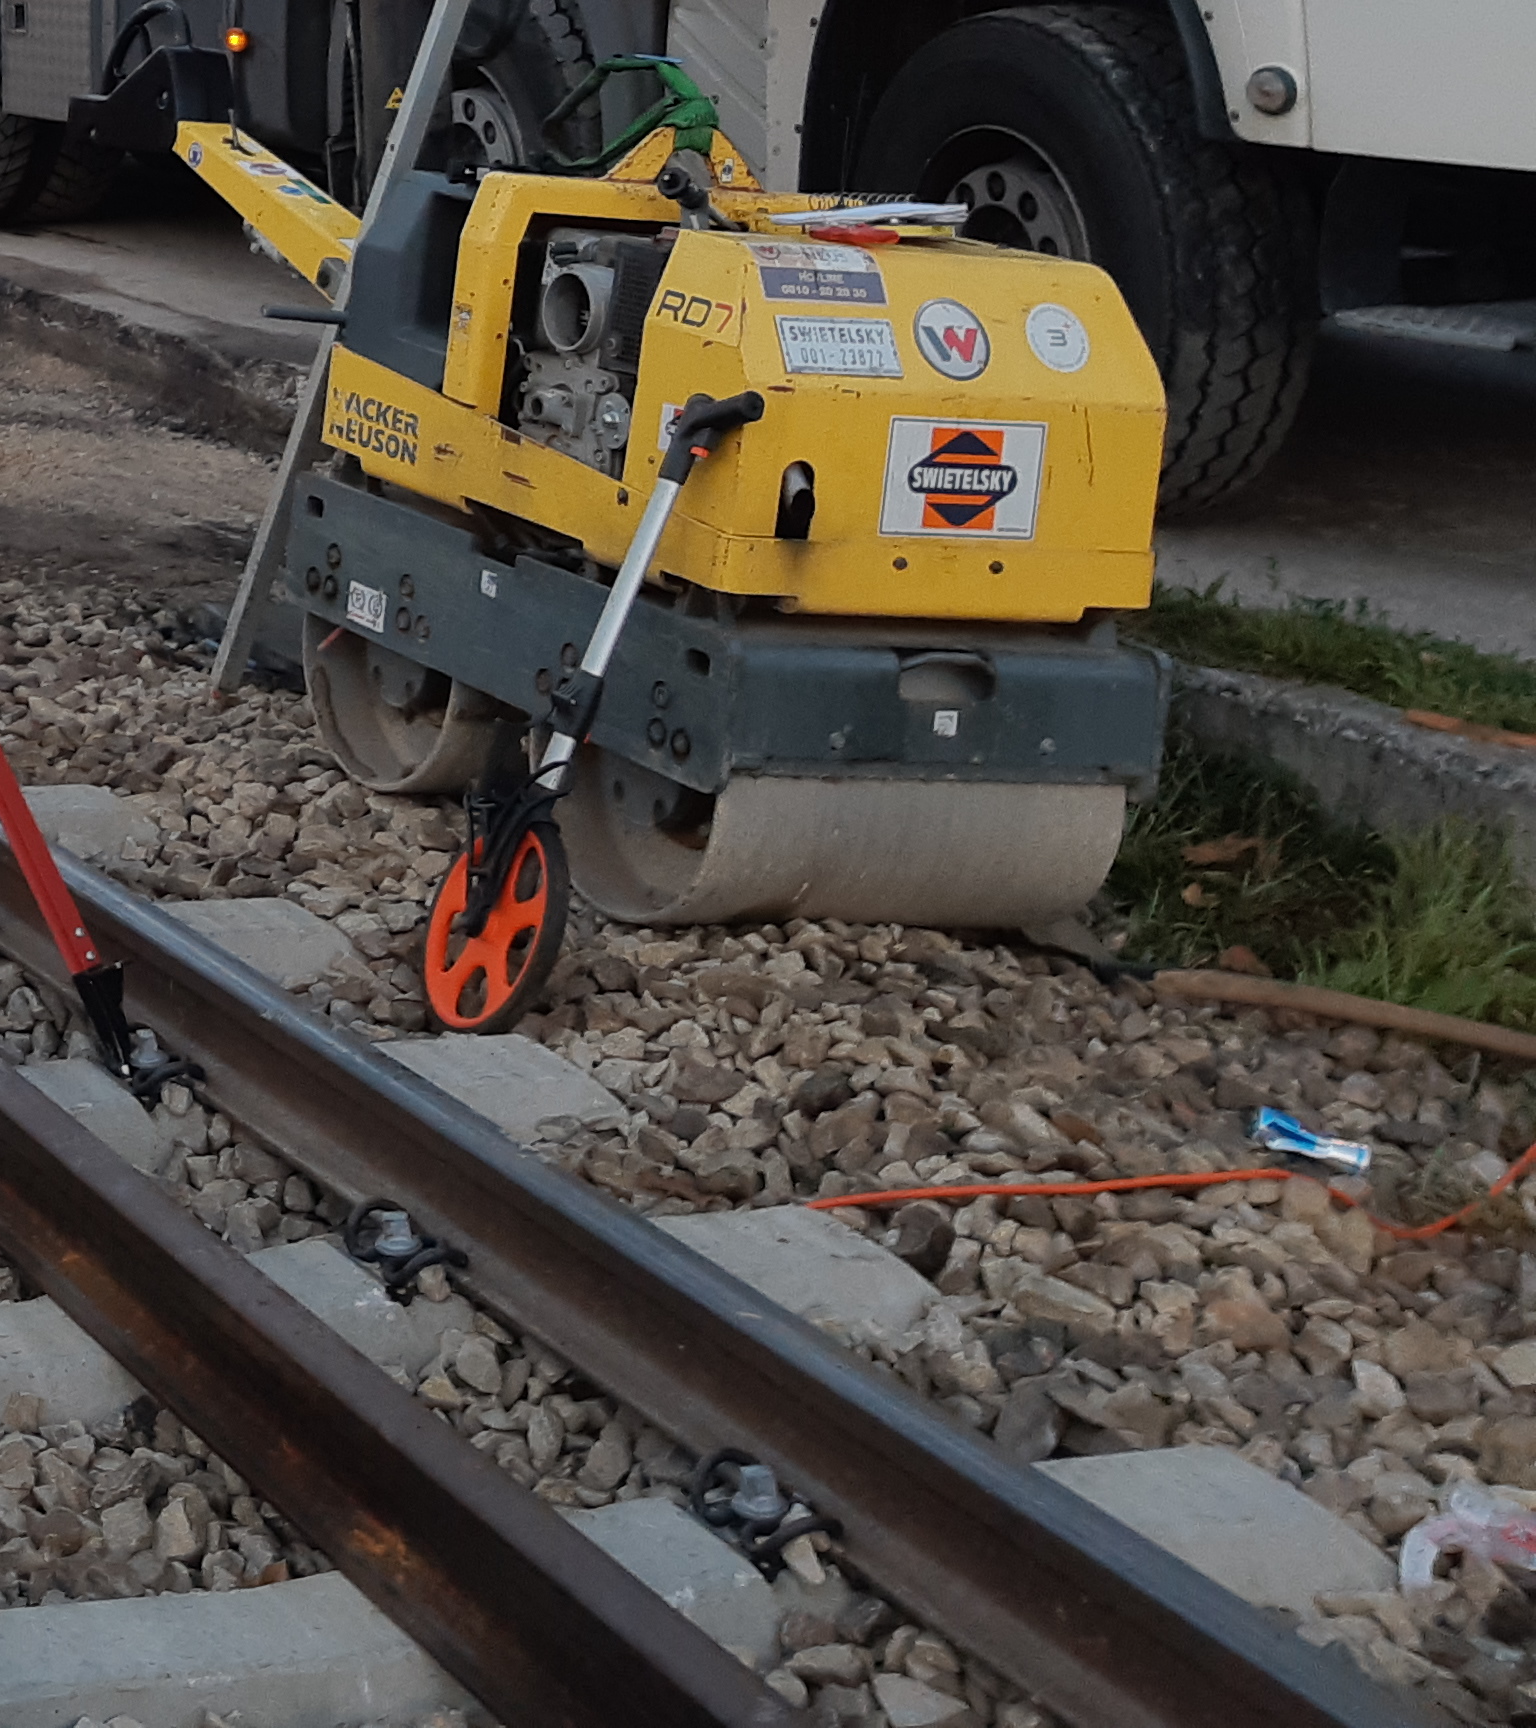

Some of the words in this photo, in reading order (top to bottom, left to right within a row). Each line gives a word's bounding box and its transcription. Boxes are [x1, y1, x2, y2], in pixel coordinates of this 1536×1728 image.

[655, 289, 734, 334] RD7
[788, 325, 886, 346] SWIETELSKY
[912, 467, 1014, 493] SWIETELSKY
